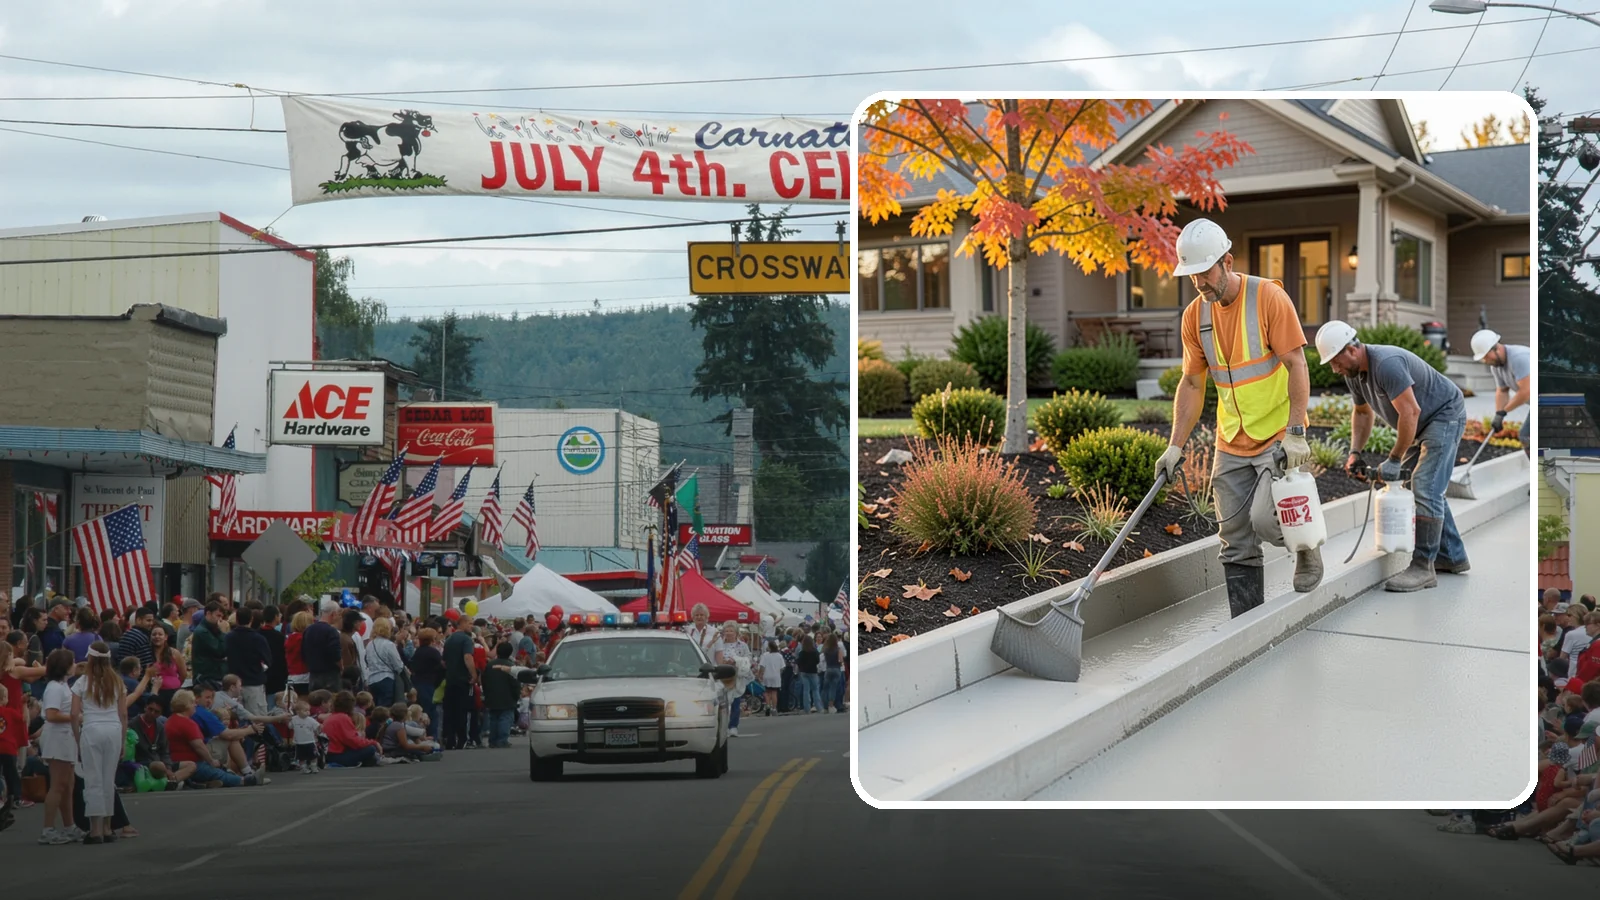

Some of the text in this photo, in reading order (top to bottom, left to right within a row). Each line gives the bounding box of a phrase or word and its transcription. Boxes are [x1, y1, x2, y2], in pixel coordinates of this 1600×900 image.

[481, 141, 605, 193] JULY
[632, 149, 746, 198] 4th.
[697, 254, 850, 280] CROSSWA
[282, 380, 373, 420] ACE
[405, 409, 453, 422] CEDAR
[283, 421, 370, 437] Hardware
[416, 428, 477, 447] Coca-Cola
[353, 467, 384, 481] Simpl
[96, 485, 124, 495] Vincent
[126, 486, 136, 495] de
[138, 486, 155, 496] Paul
[212, 515, 331, 536] HARDARE
[688, 526, 741, 535] CRNATION
[699, 535, 730, 543] GLASS
